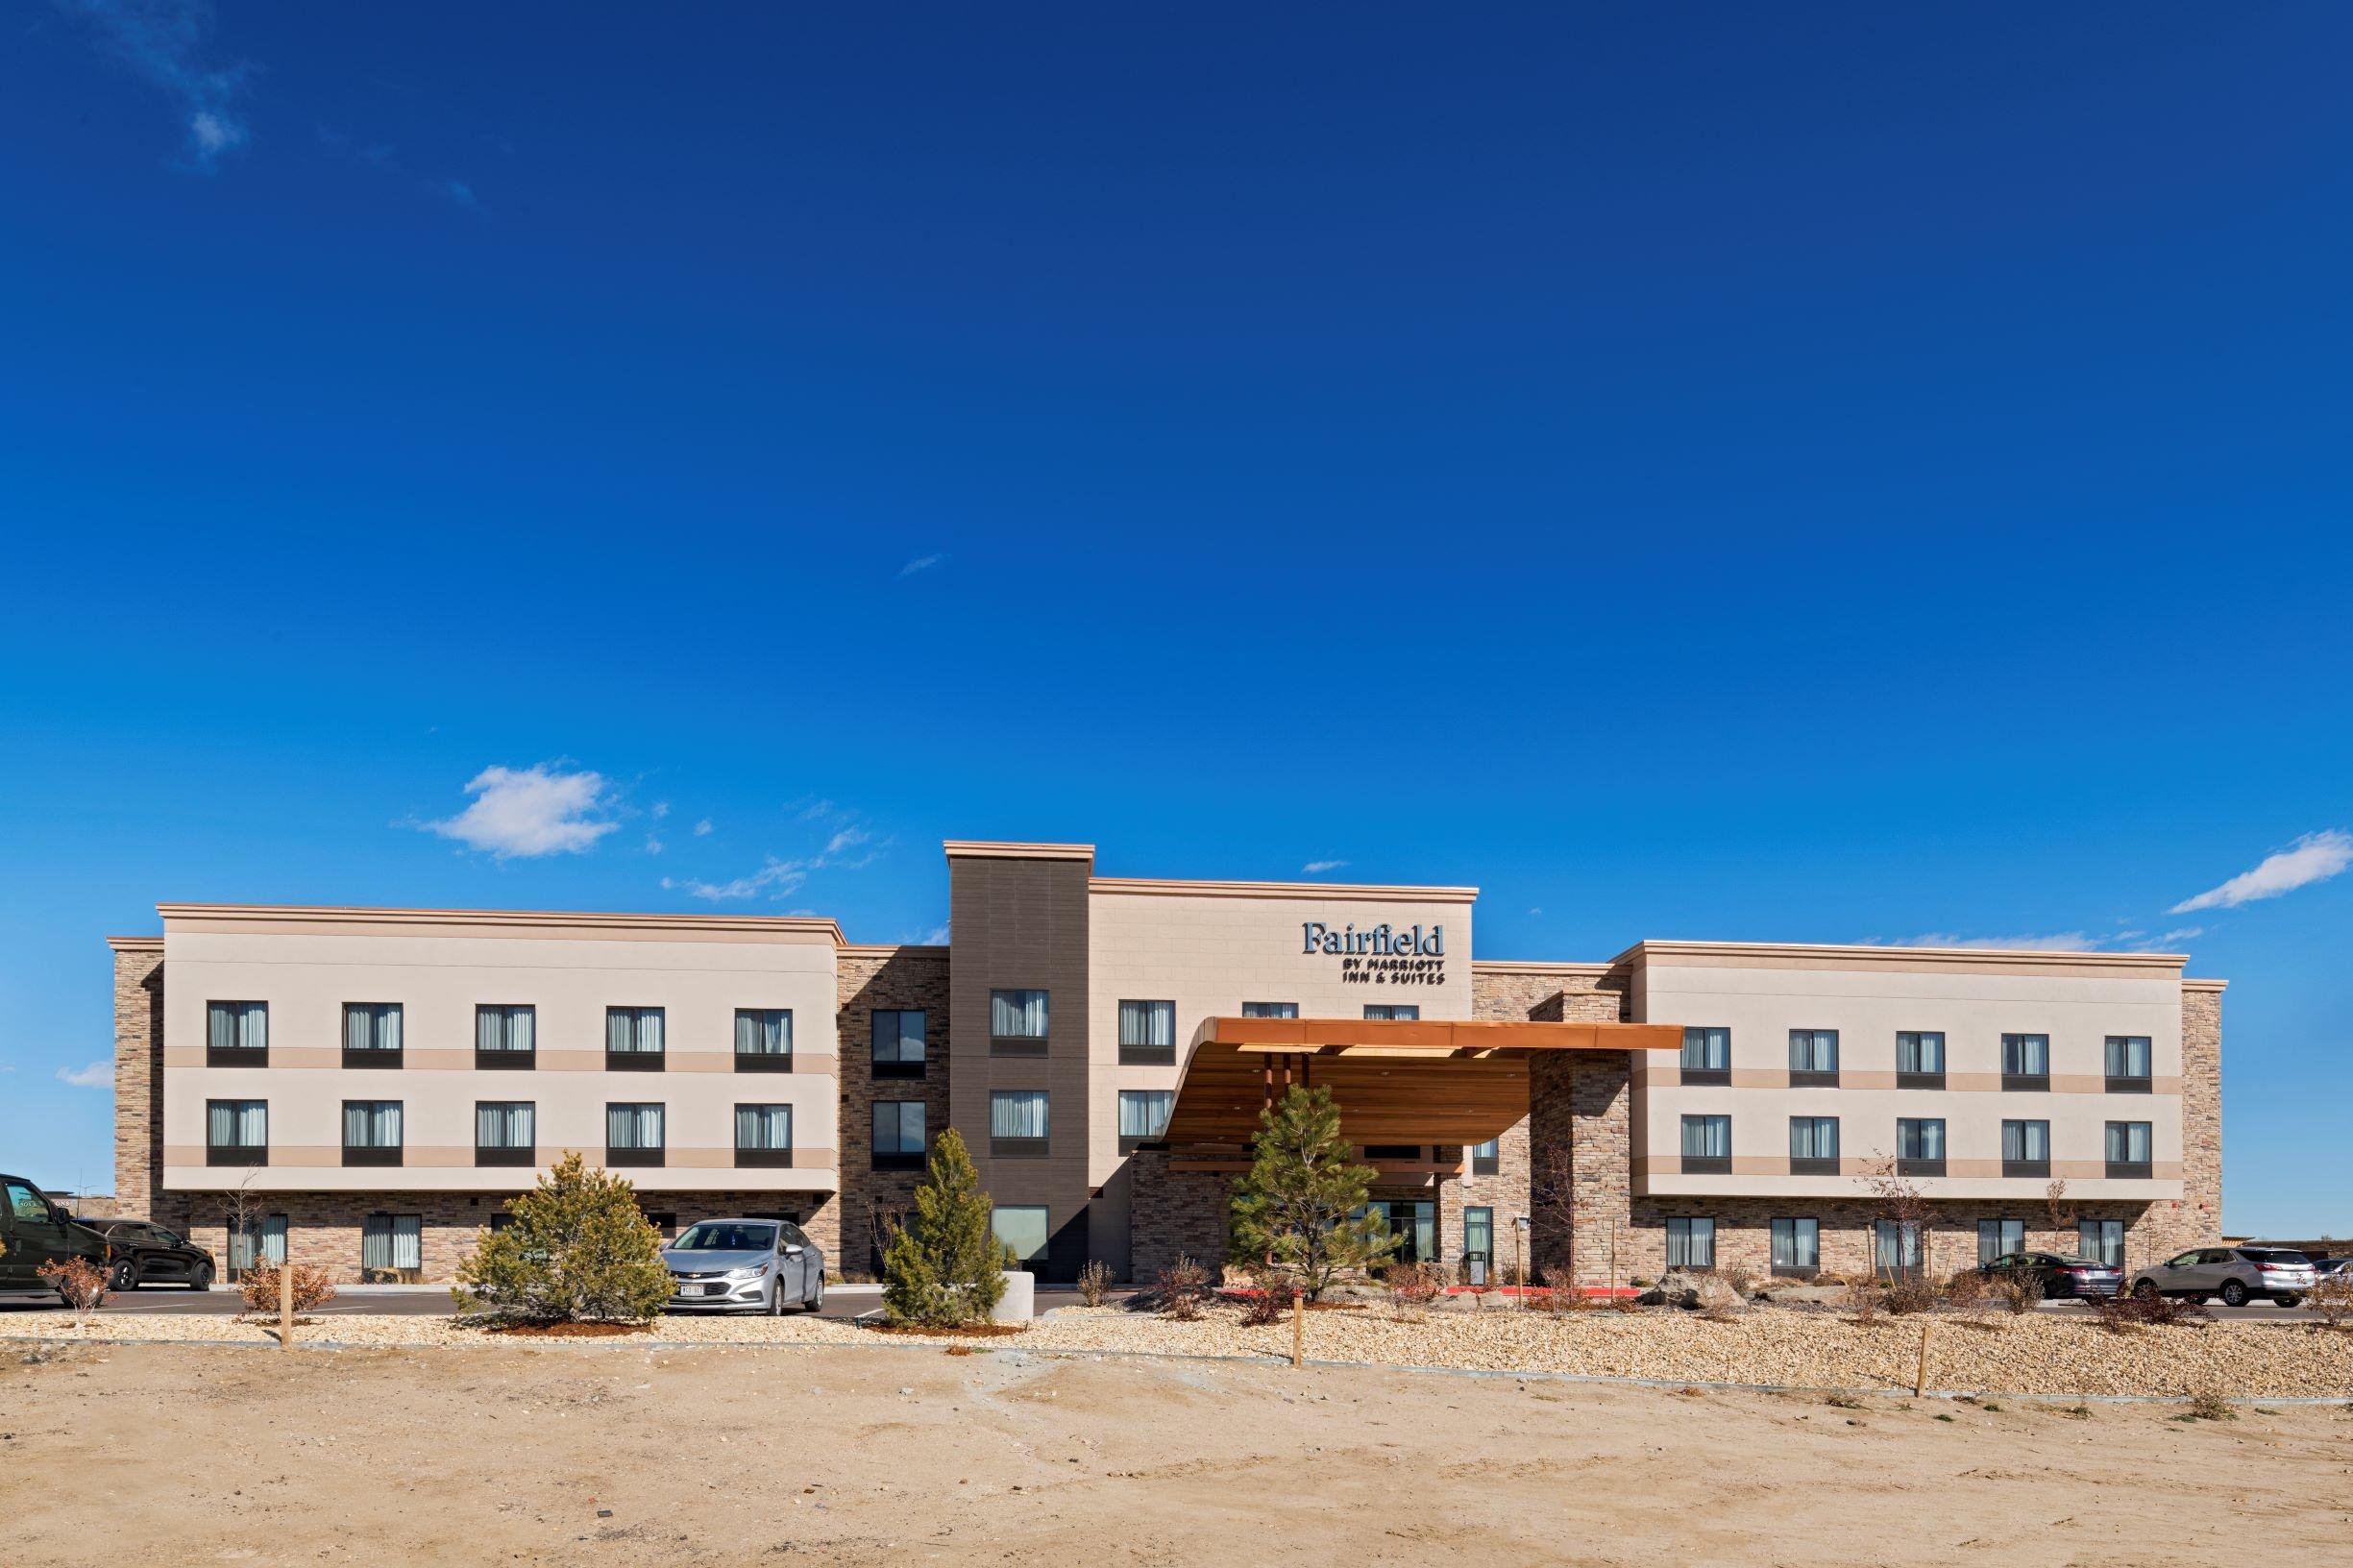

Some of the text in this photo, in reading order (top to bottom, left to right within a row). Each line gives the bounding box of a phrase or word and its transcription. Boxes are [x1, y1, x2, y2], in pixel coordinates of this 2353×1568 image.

[1302, 921, 1445, 957] Fairfield
[1342, 958, 1445, 972] BY MARRIOTT
[1342, 970, 1445, 985] INN & SUITES
